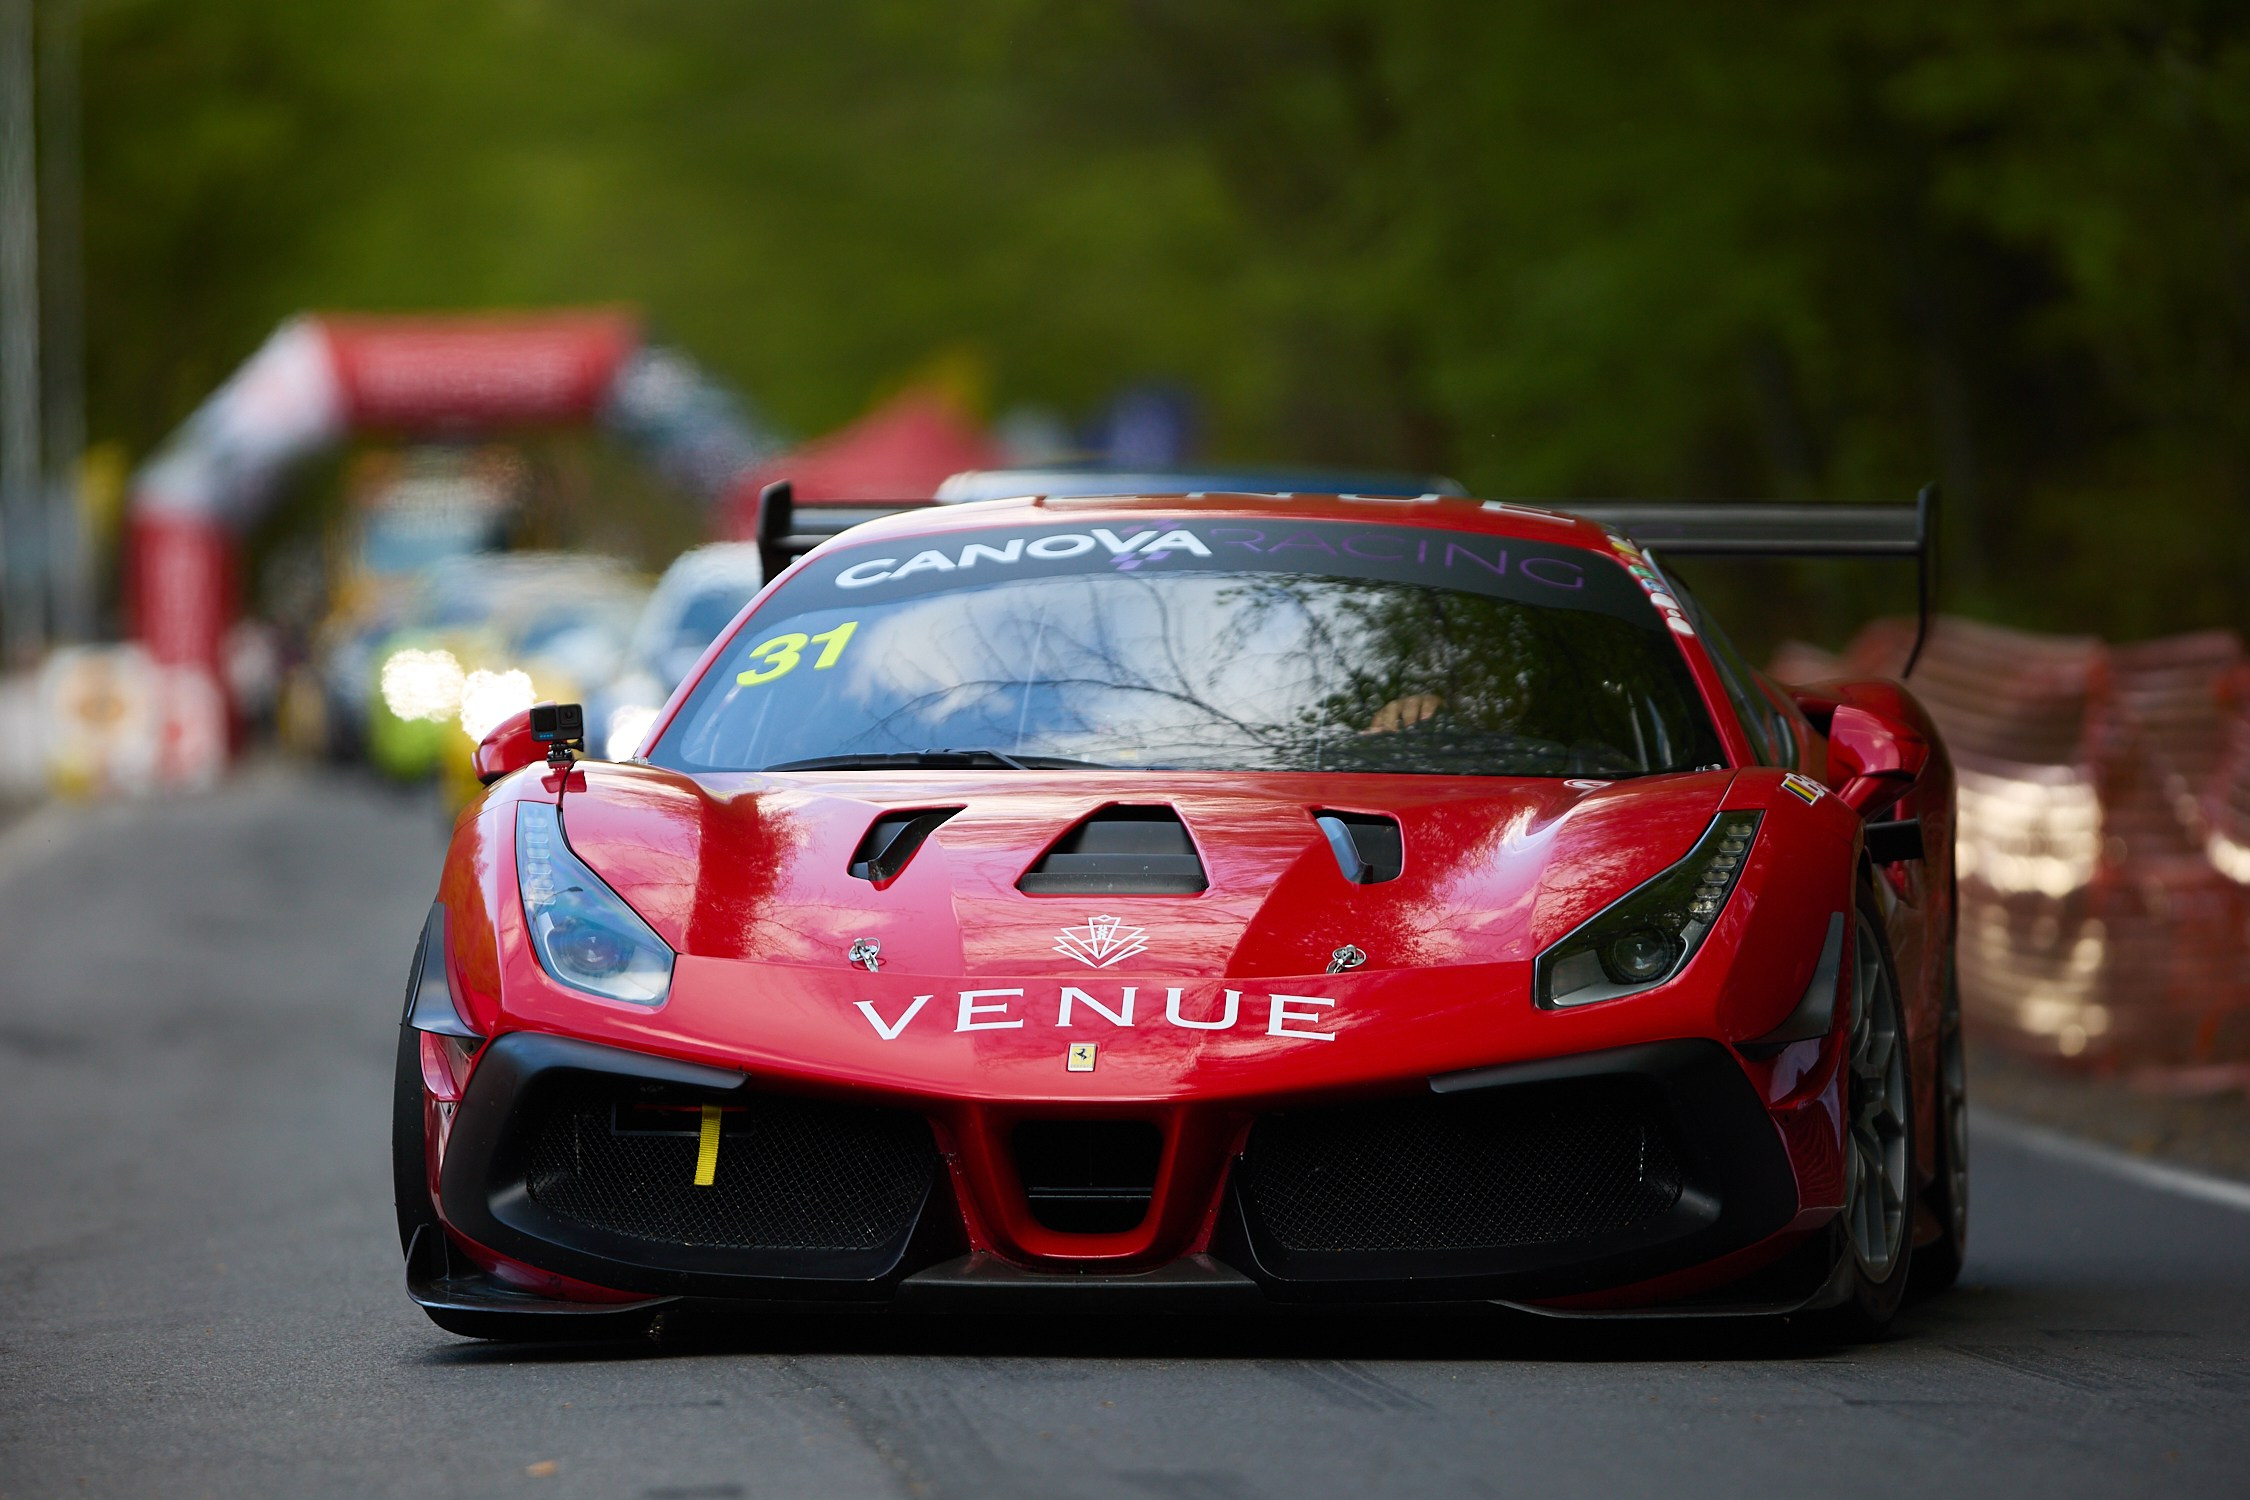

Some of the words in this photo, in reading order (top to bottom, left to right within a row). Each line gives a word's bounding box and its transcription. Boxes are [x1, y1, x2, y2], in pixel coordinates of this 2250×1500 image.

[834, 528, 1212, 589] CANOVA
[1213, 528, 1583, 589] RACING
[735, 620, 859, 687] 31
[853, 986, 1336, 1041] VENUE
